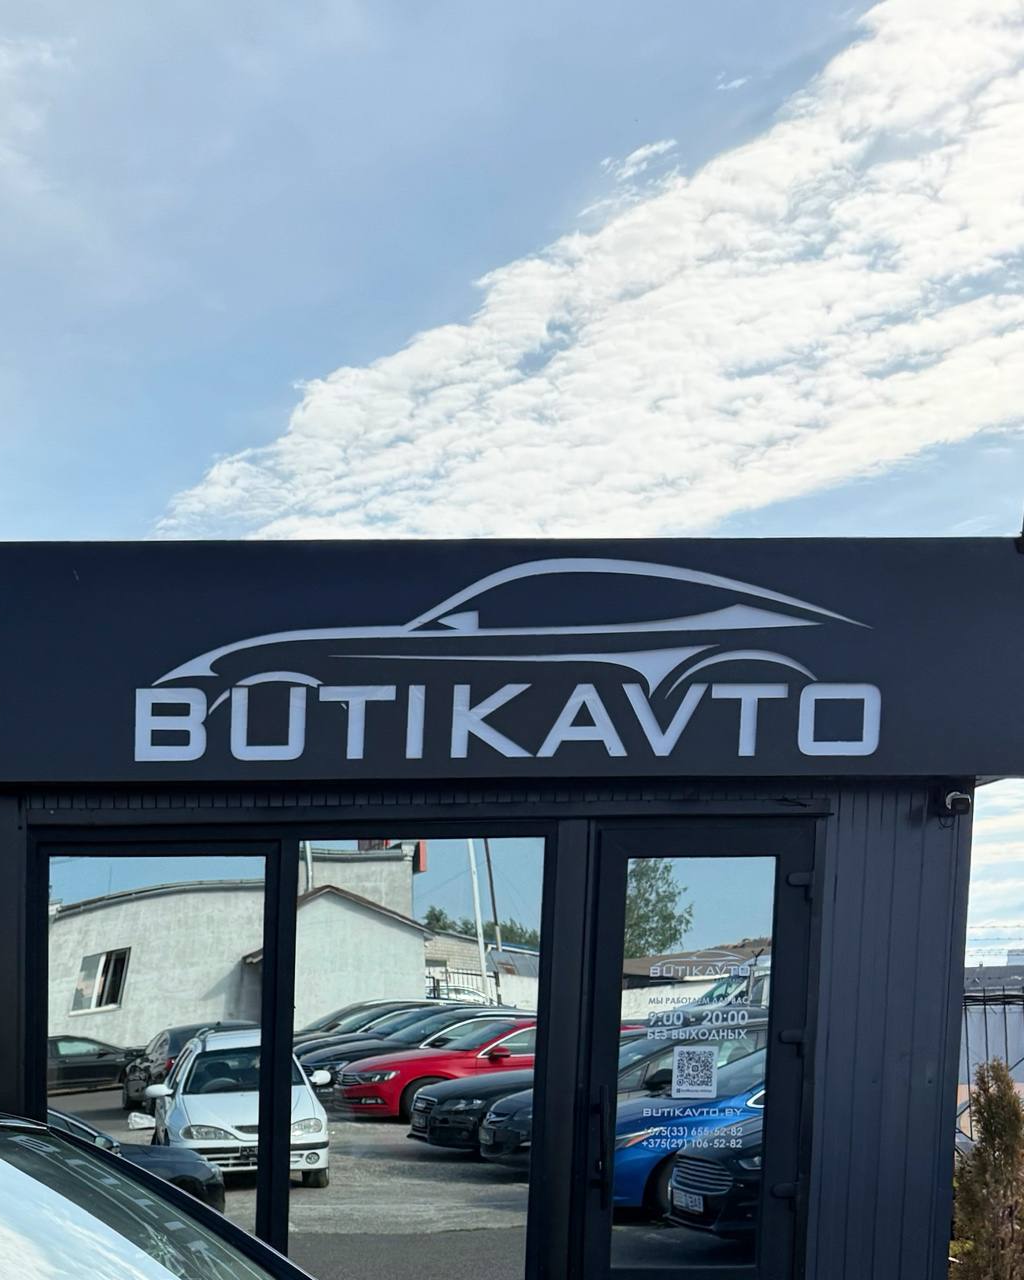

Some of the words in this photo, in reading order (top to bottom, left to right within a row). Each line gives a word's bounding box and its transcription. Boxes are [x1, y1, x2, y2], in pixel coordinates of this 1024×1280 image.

[134, 682, 882, 762] BUTIKAVTO
[649, 965, 752, 977] BUTIKAVTO
[701, 1010, 749, 1025] 20:00
[647, 1028, 668, 1040] БЕЗ
[671, 1029, 748, 1041] ВЫХОДНЫХ
[642, 1107, 744, 1117] BUTIKAVTO.BY
[642, 1138, 688, 1150] +375(29)
